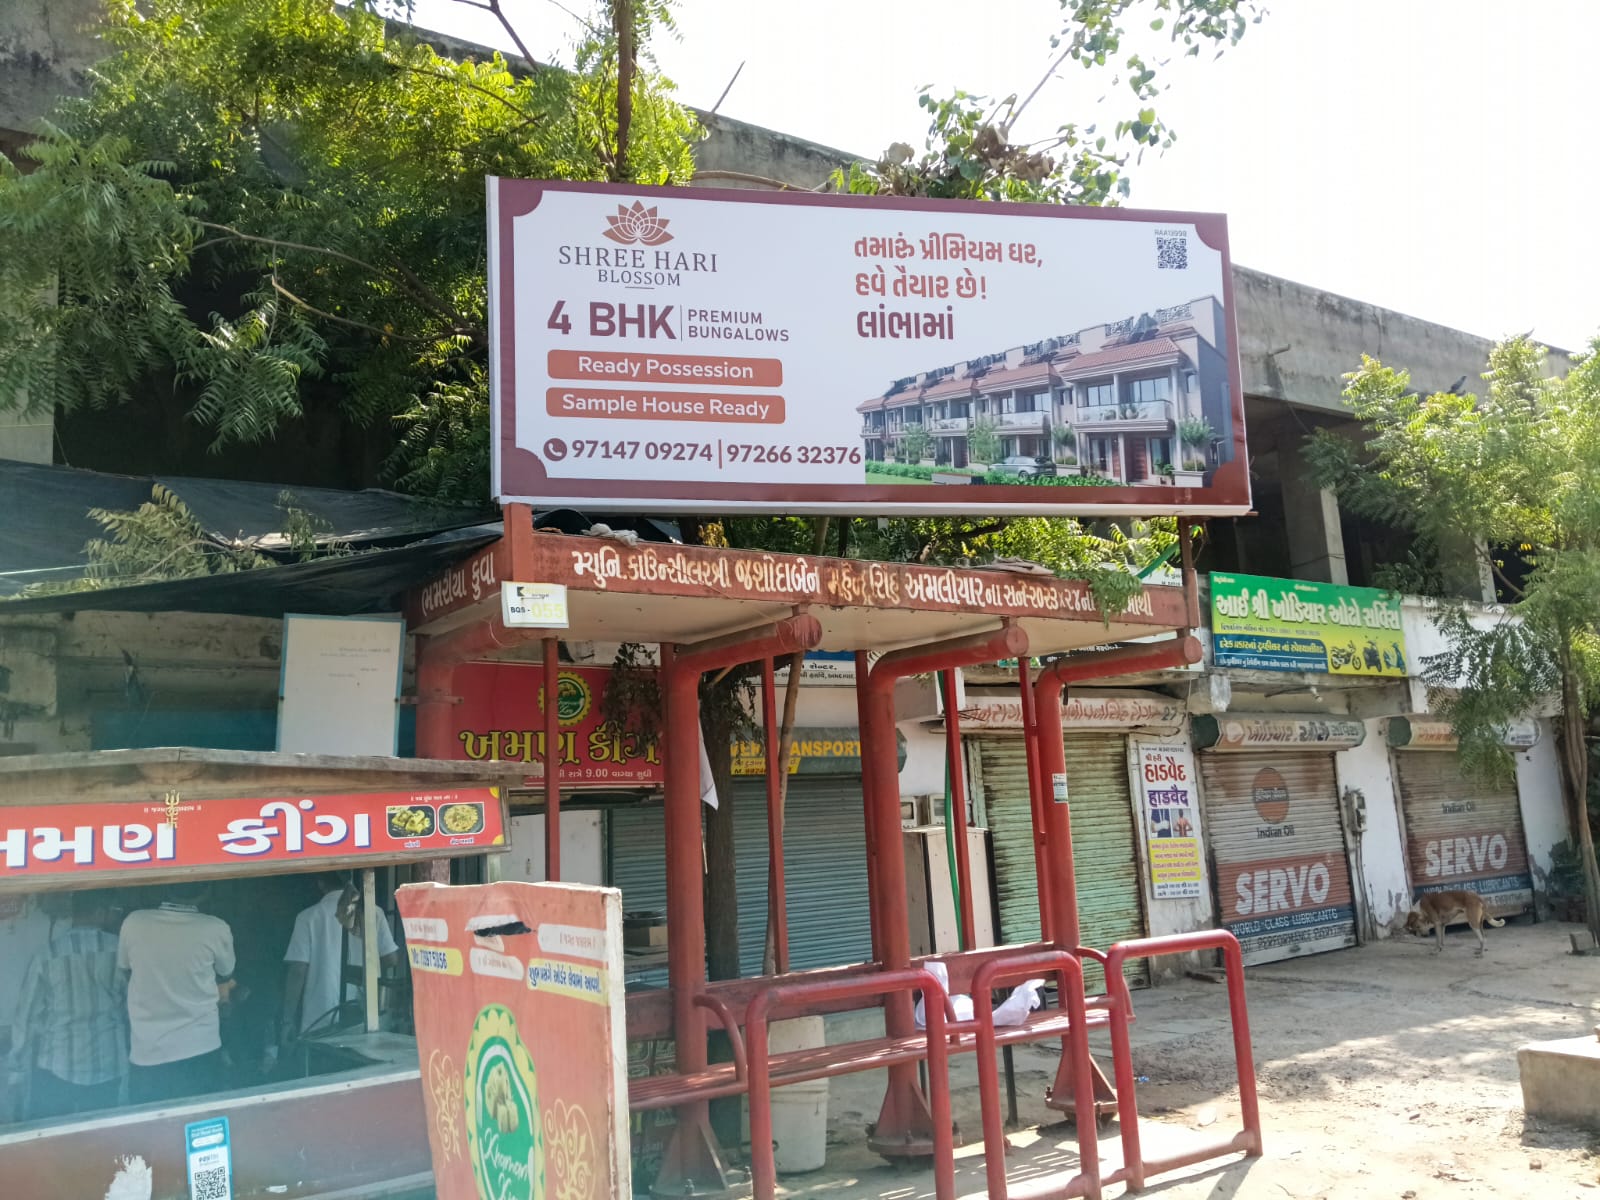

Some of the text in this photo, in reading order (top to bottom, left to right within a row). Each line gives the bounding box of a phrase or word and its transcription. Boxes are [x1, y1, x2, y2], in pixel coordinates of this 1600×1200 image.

[558, 245, 718, 272] SHREE HARI
[854, 232, 1044, 268] તમારું પ્રીમિયમ ઘર,
[598, 269, 682, 287] BLOSSOM
[855, 264, 987, 300] હવે તૈયાર છે!
[546, 300, 677, 340] 4 BHK
[687, 309, 762, 325] PREMIUM
[856, 303, 954, 340] લાંભામાં
[687, 325, 790, 343] BUNGALOWS
[578, 356, 754, 379] Ready Possession
[562, 394, 770, 419] Sample House Ready
[572, 439, 861, 465] 97147 09274 97266 32376
[531, 603, 566, 620] 055
[789, 741, 862, 757] ANSPORT
[217, 800, 370, 854] કીંગ
[1425, 834, 1509, 878] SERVO
[1235, 862, 1330, 916] SERVO
[1291, 908, 1339, 926] LUBRICANTS
